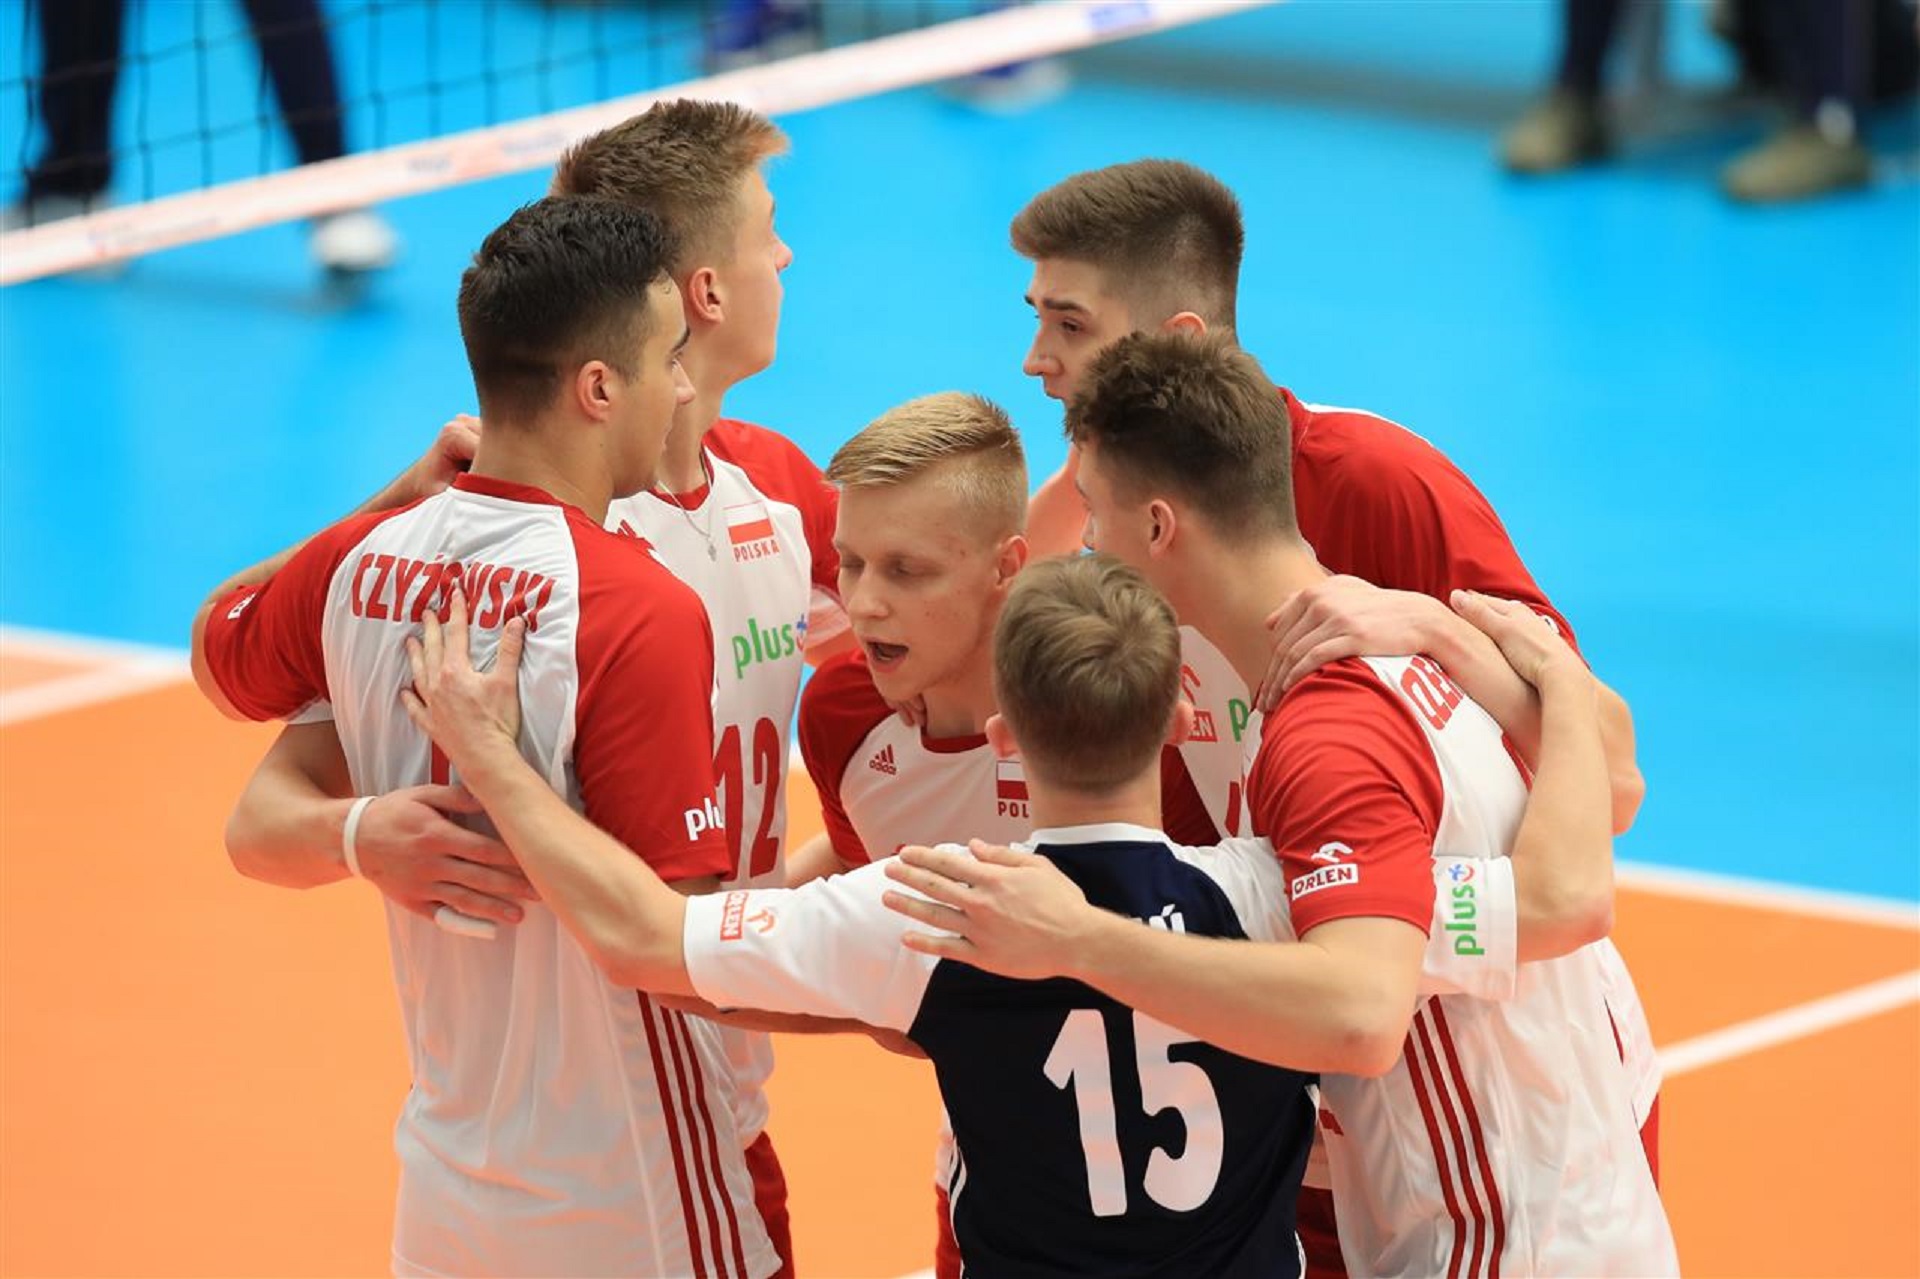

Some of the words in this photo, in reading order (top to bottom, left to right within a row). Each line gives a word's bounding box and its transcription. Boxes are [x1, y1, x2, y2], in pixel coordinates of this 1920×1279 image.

[734, 539, 780, 562] POLSKA
[732, 618, 795, 679] plus
[869, 759, 897, 775] adidas
[713, 717, 780, 882] 12
[1294, 868, 1352, 894] ORLEN
[722, 892, 745, 938] ORLEN
[1445, 885, 1484, 955] plus
[1043, 1009, 1224, 1216] 15
